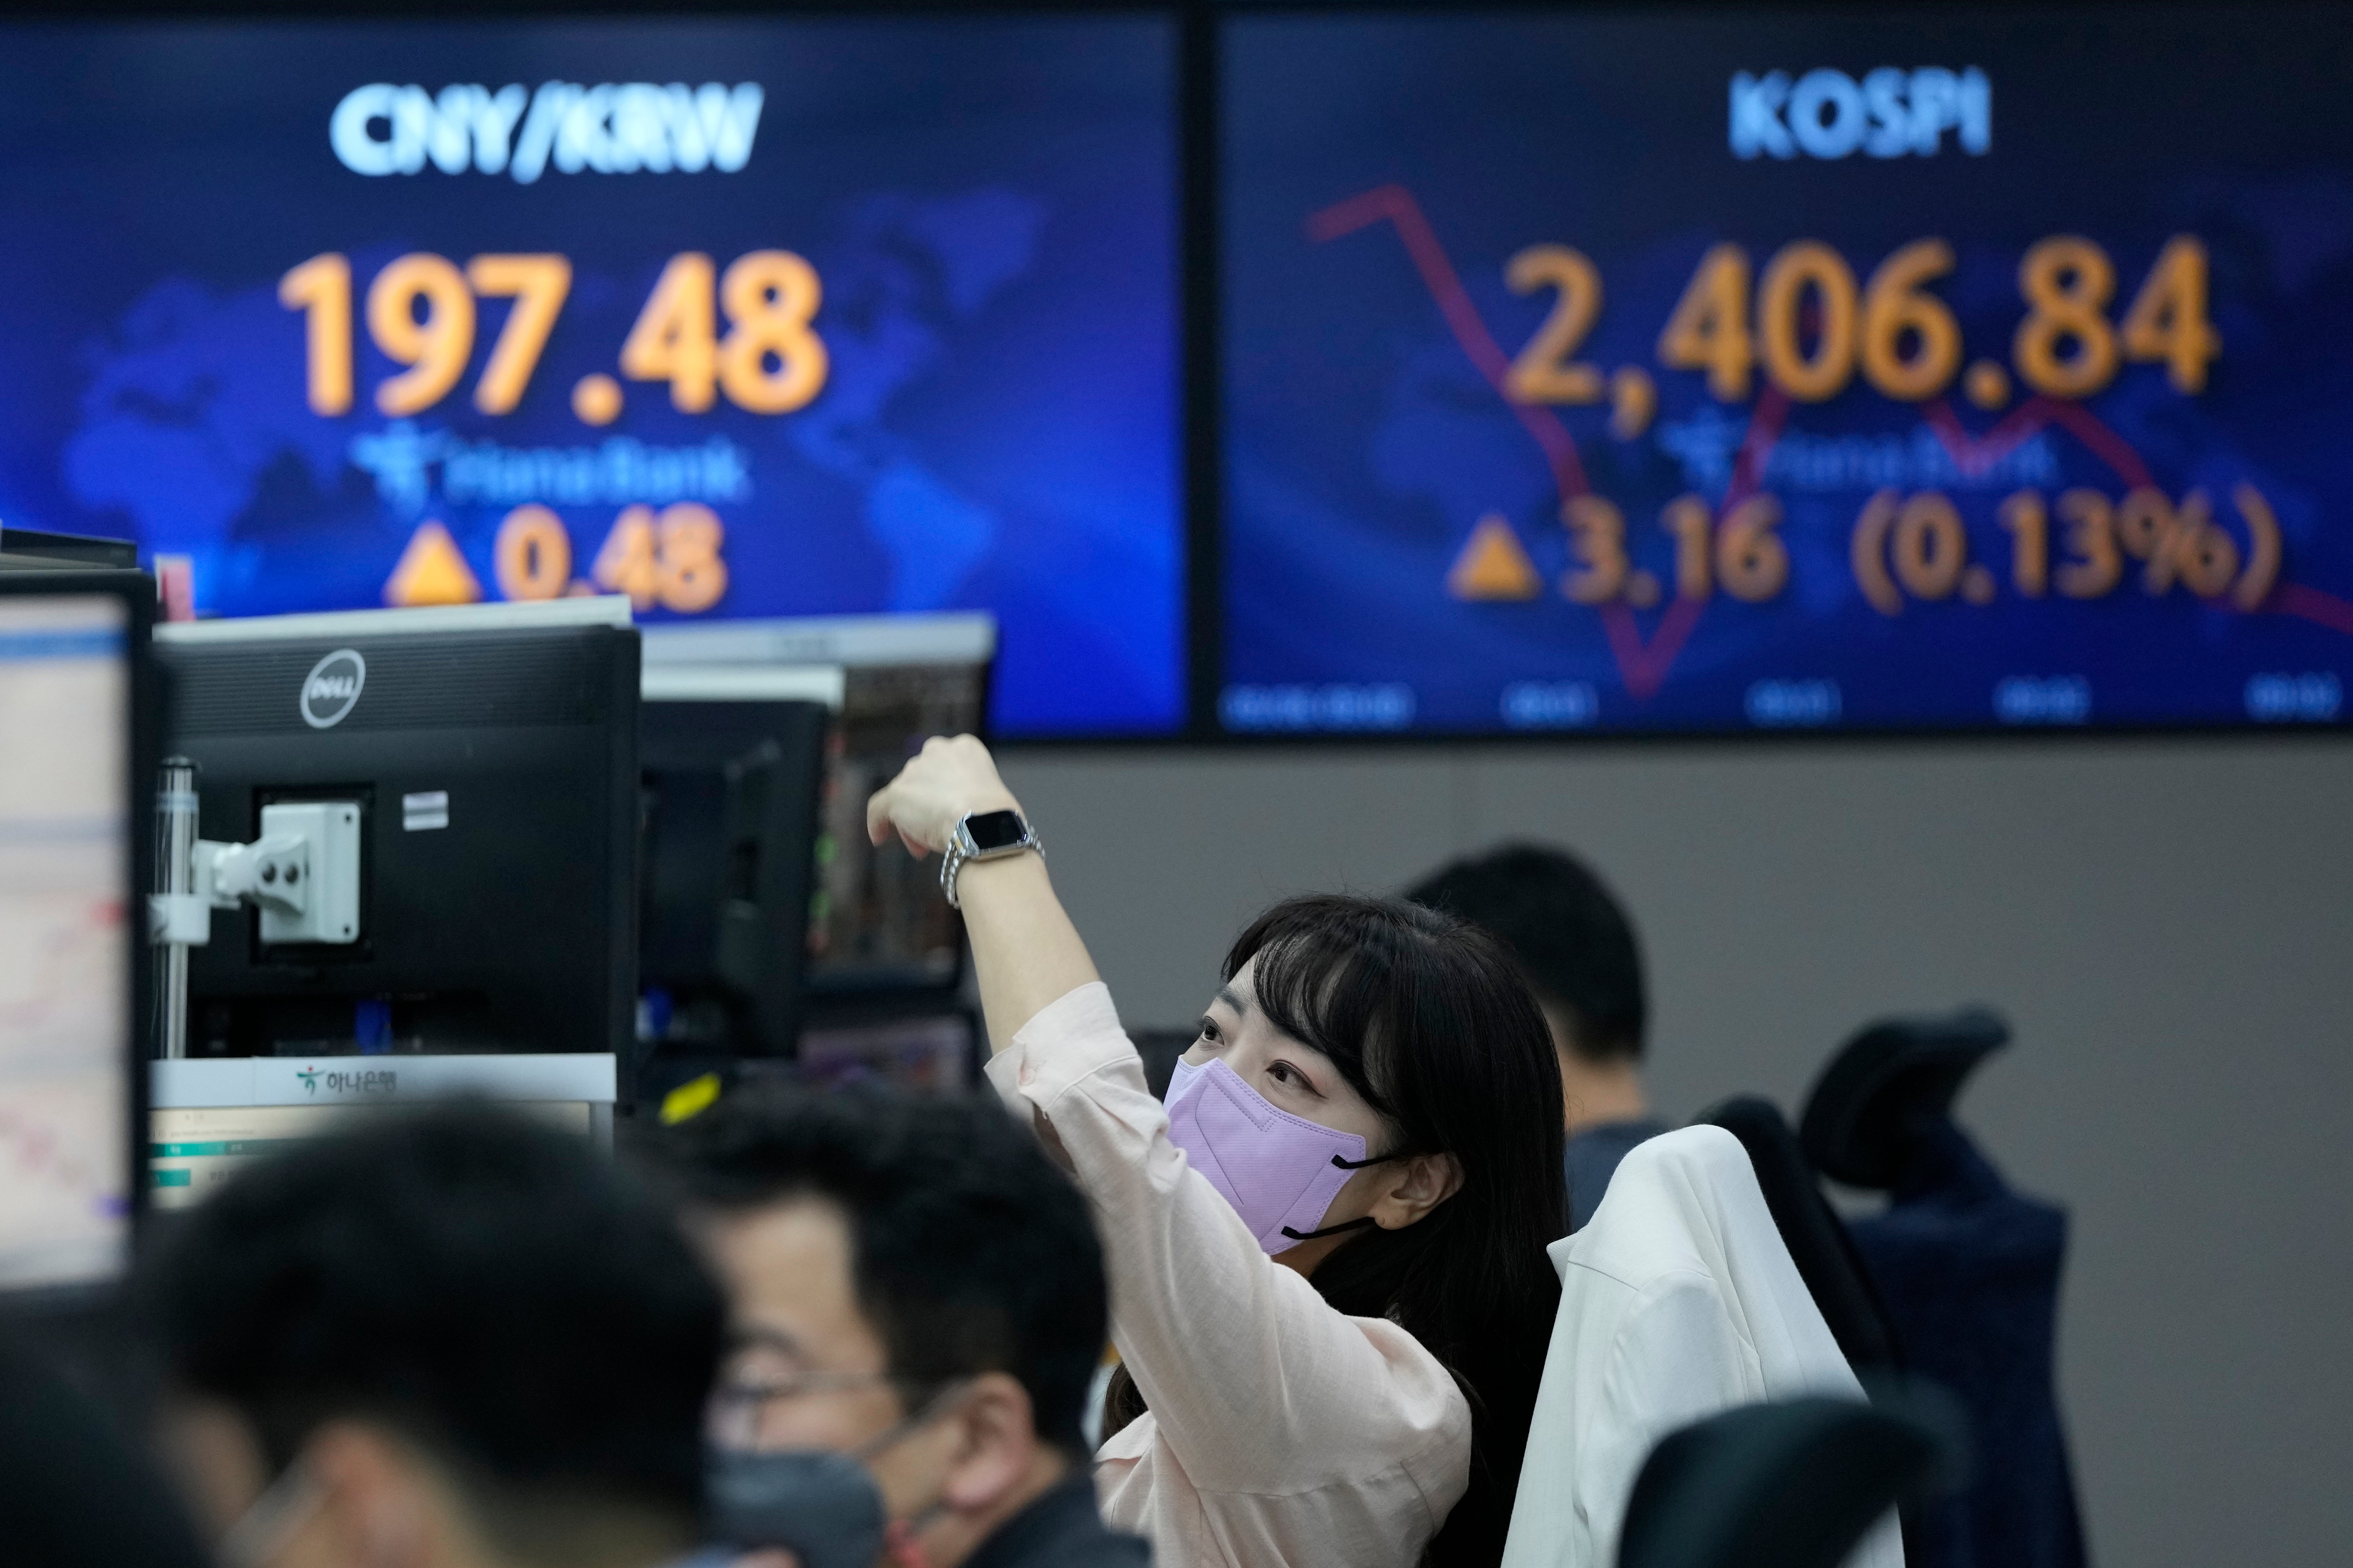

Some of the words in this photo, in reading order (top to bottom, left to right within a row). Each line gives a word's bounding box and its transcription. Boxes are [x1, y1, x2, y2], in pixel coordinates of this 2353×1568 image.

[331, 81, 765, 184] CNY/KRW
[1727, 66, 1993, 160] KOSPI
[280, 251, 828, 425] 197.48
[1502, 236, 2219, 441] 2,406.84
[494, 501, 728, 614] 0.48
[1560, 492, 1790, 610] 3.16
[1853, 485, 2282, 617] (0.13%)
[309, 677, 355, 700] DELL
[327, 1071, 397, 1093] 하나은행
